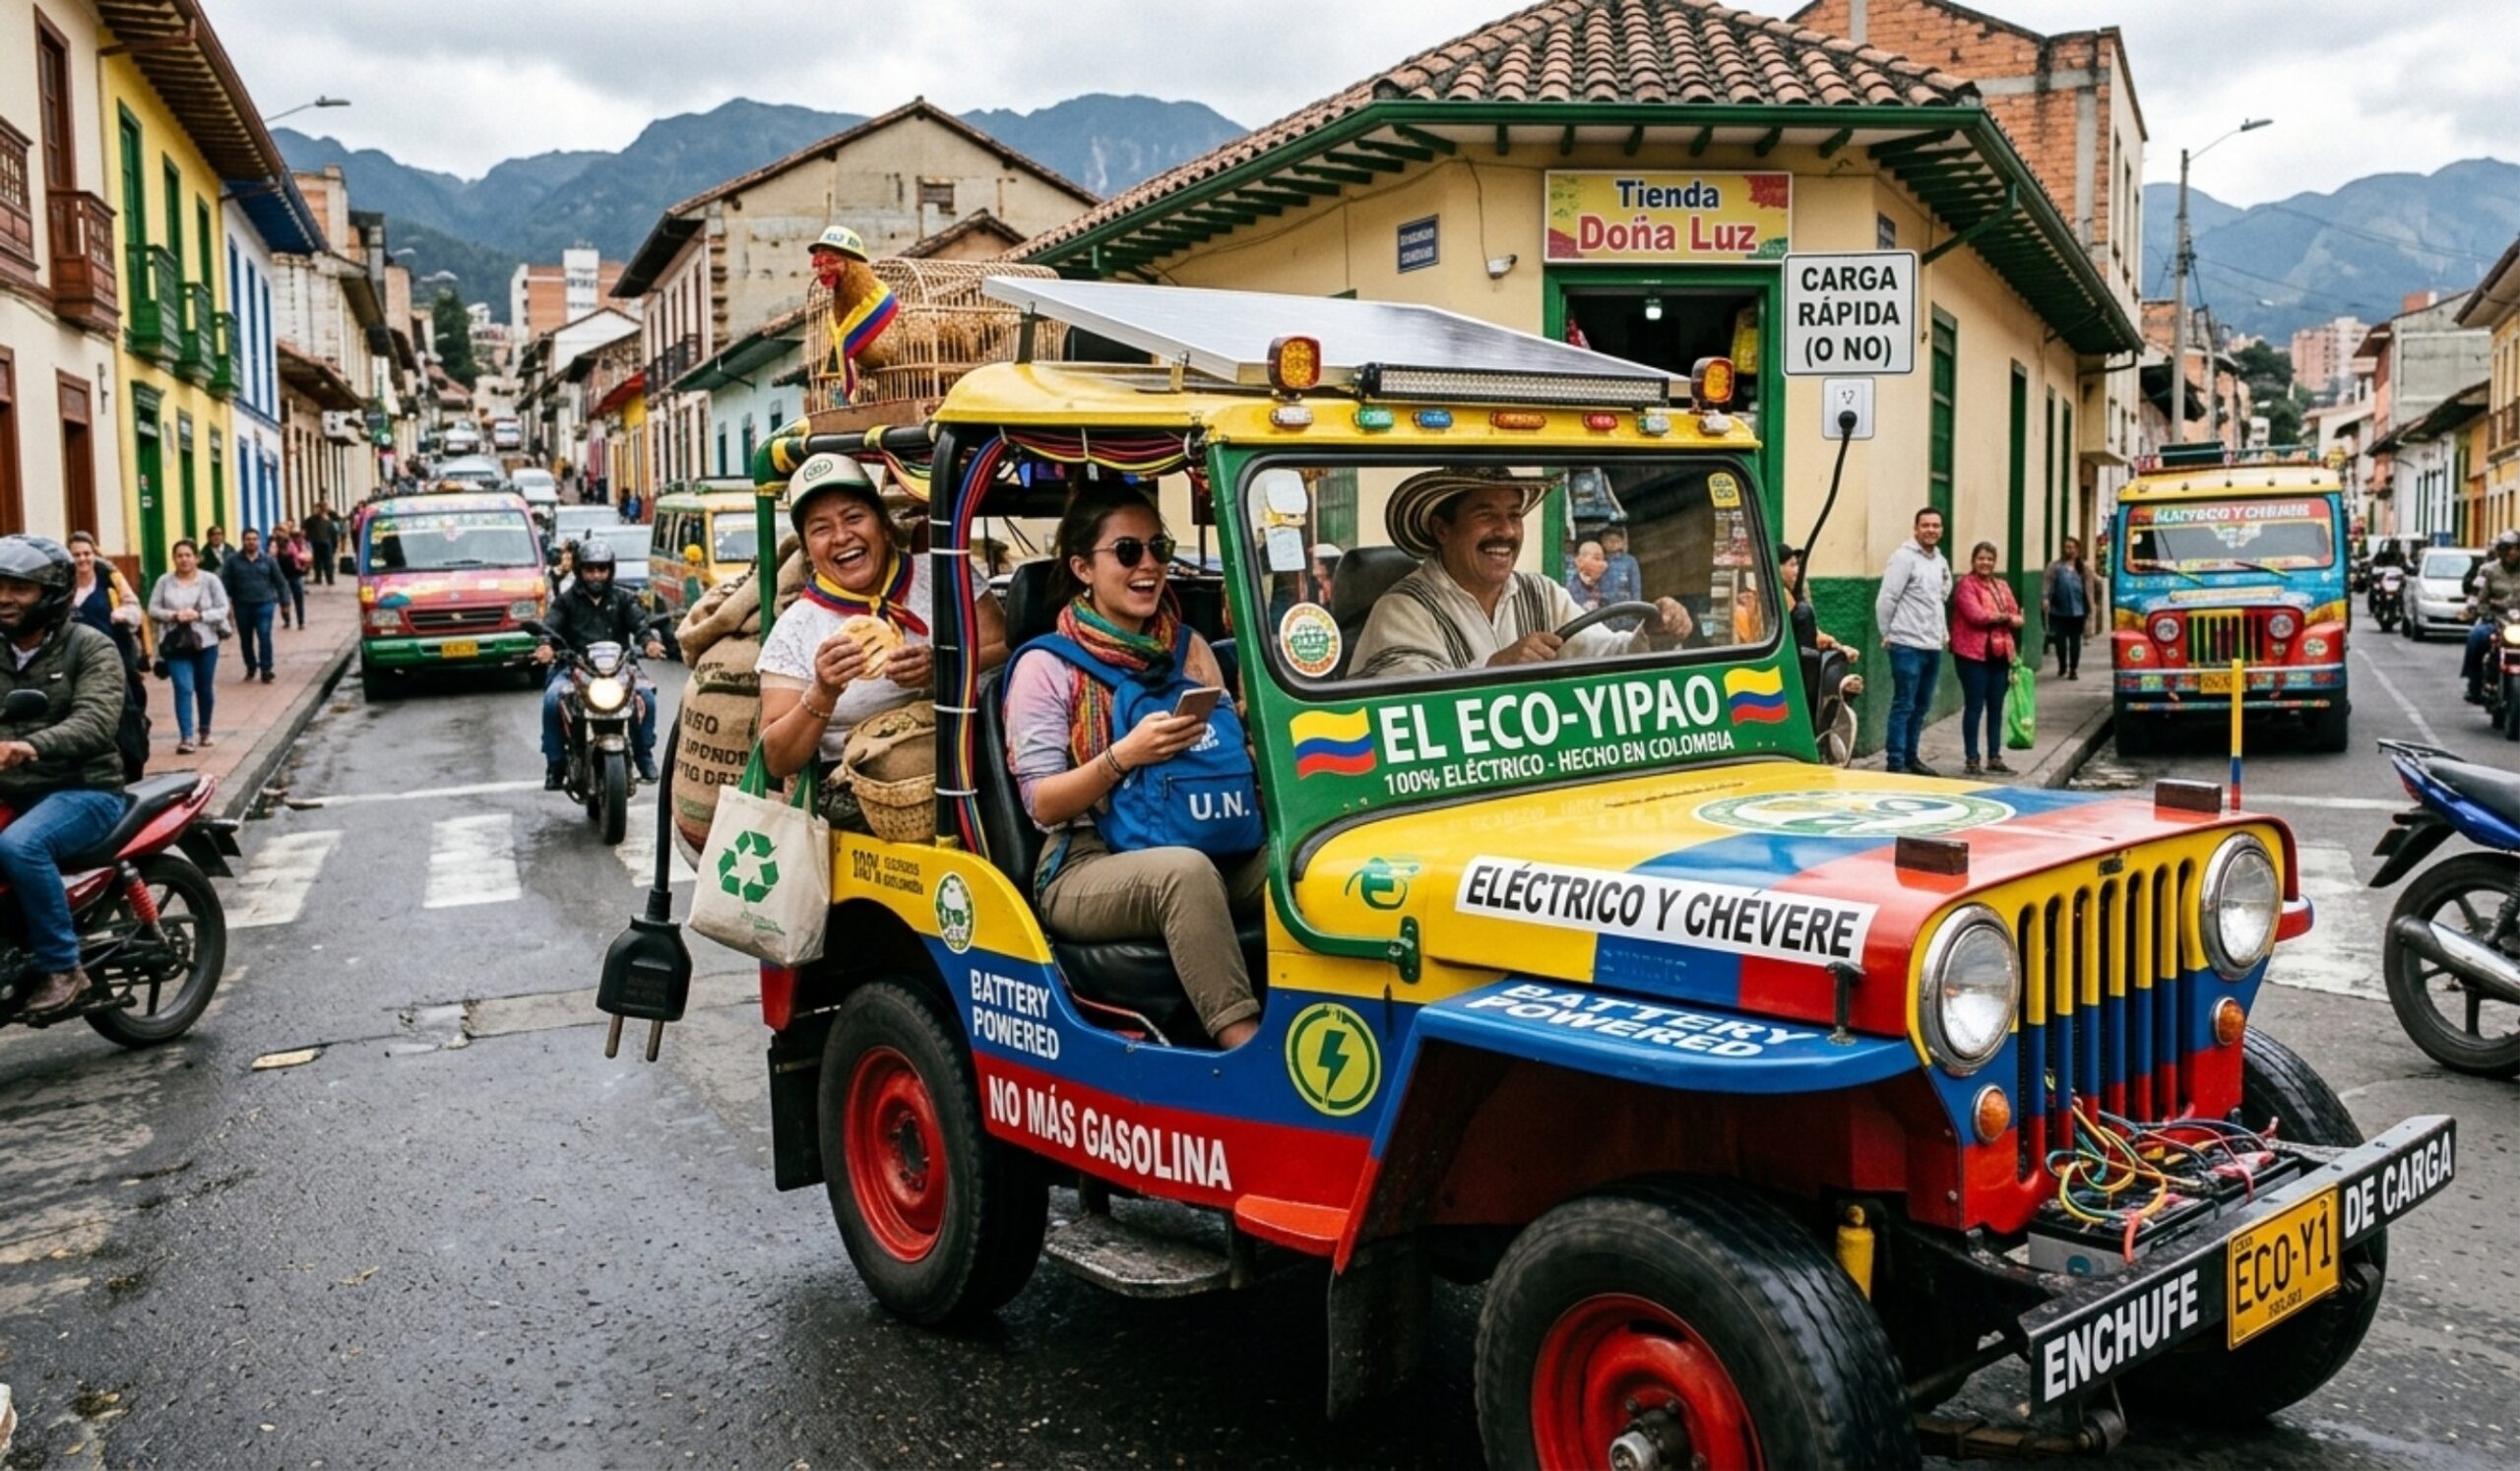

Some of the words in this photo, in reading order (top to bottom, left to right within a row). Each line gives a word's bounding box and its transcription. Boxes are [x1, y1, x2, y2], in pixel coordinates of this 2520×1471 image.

[1616, 180, 1720, 208] Tienda
[1691, 216, 1756, 250] Luz
[1800, 266, 1898, 291] CARGA
[1798, 295, 1901, 326] RÁPIDA
[1804, 336, 1834, 368] (O
[1844, 335, 1892, 368] NO)
[1378, 704, 1448, 764] EL
[1455, 674, 1720, 754] ECO-YIPAO
[1383, 768, 1440, 796] 100%
[1443, 753, 1544, 789] ELÉCTRICO
[1557, 744, 1620, 773] HECHO
[1622, 740, 1647, 763] EN
[1649, 730, 1735, 759] COLOMBIA
[1189, 791, 1251, 821] U.N.
[1465, 862, 1646, 928] ELÉCTRICO
[1654, 887, 1682, 931] Y
[1684, 888, 1859, 958] CHÉVERE
[970, 968, 1050, 1019] BATTERY
[1497, 984, 1820, 1045] BATTERY
[972, 1006, 1060, 1060] POWERED
[1466, 994, 1765, 1057] POWERED
[988, 1074, 1021, 1127] NO
[1027, 1083, 1077, 1149] MÁS
[1082, 1107, 1232, 1191] GASOLINA
[2044, 1268, 2199, 1403] ENCHUFE
[2345, 1175, 2375, 1240] DE
[2382, 1130, 2453, 1215] CARGA
